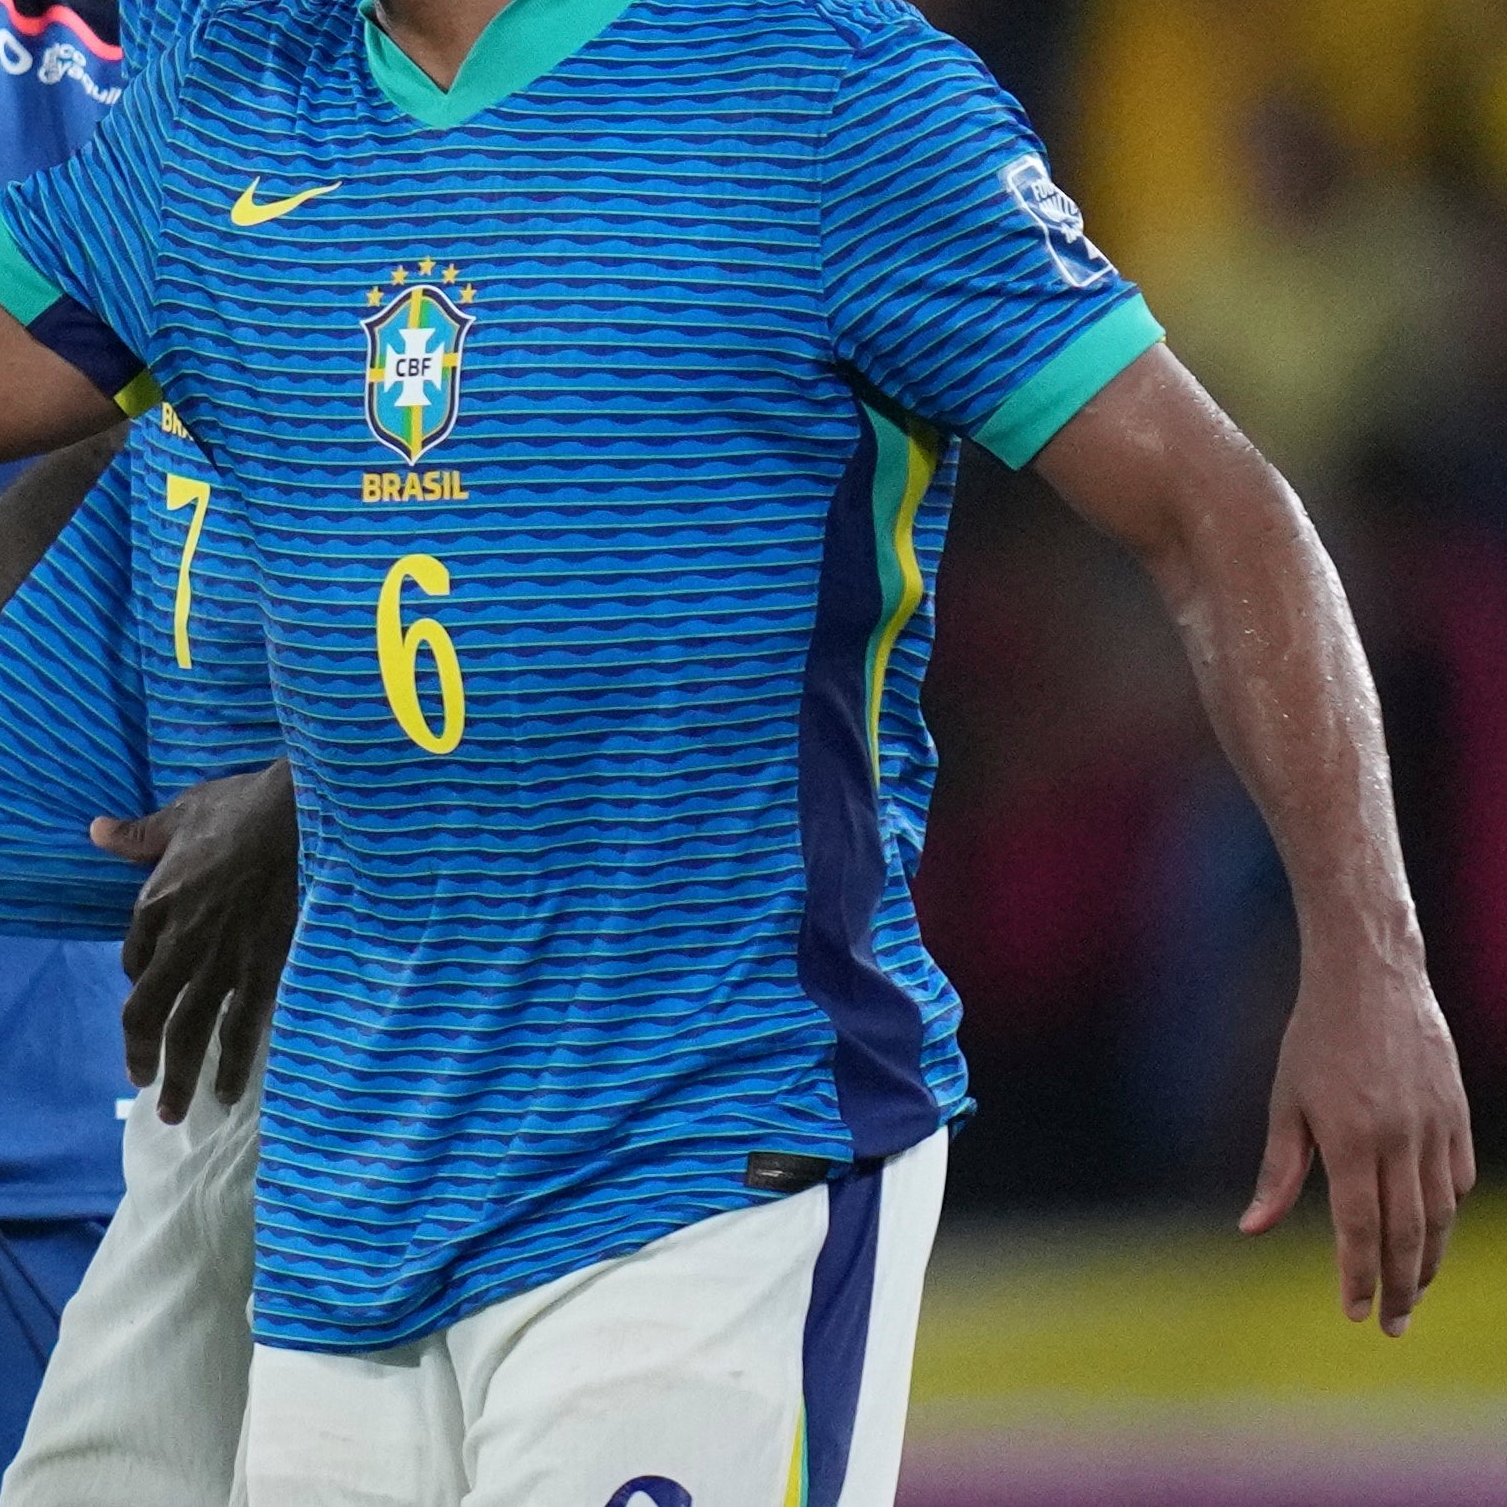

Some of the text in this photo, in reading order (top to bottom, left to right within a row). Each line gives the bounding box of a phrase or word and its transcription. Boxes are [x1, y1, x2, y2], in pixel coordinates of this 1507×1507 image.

[395, 357, 433, 377] CBF
[361, 470, 470, 504] BRASIL
[166, 473, 211, 670] 7
[376, 553, 466, 755] 6
